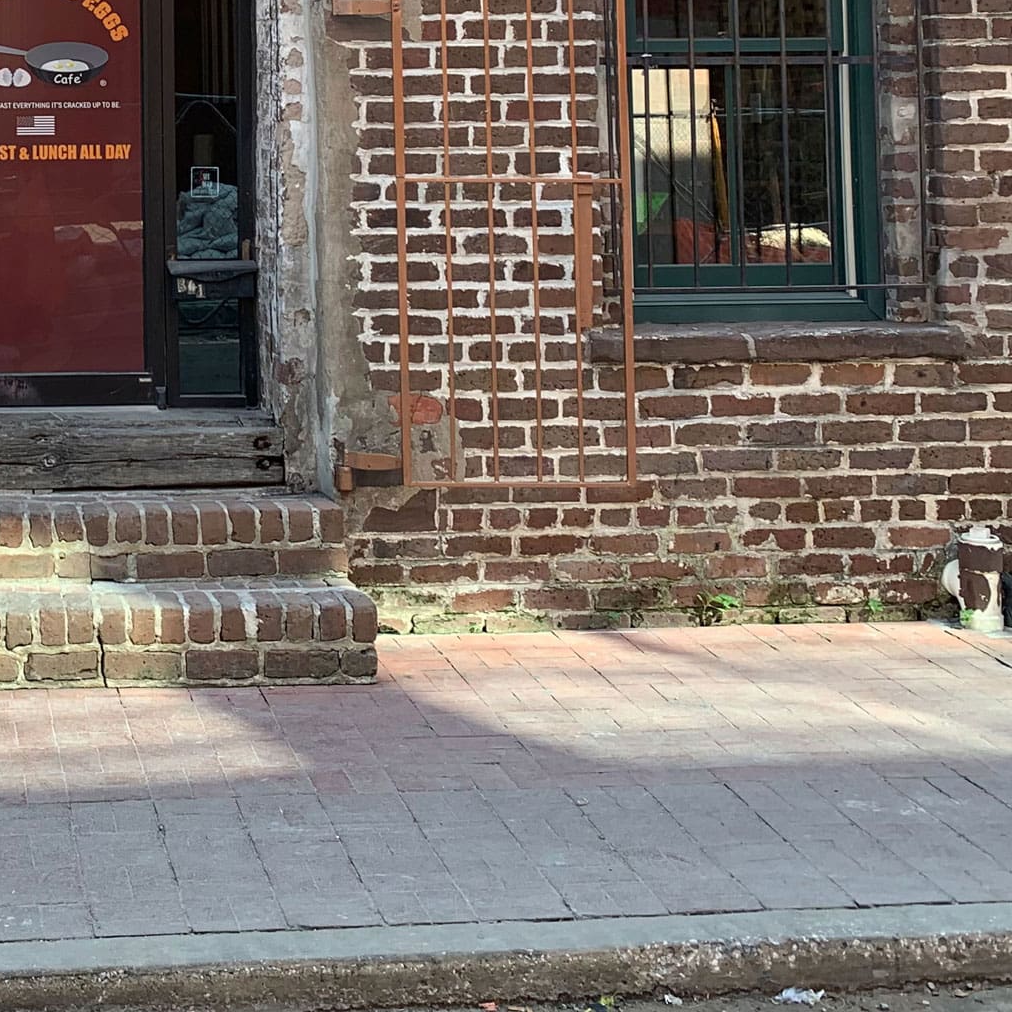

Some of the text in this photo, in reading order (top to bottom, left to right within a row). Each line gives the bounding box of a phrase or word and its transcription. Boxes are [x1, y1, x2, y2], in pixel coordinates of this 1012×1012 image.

[12, 101, 50, 109] EVERYTHING
[51, 101, 63, 109] IT'S
[63, 101, 91, 109] CRACKED
[92, 101, 101, 109] UP
[102, 101, 111, 109] TO
[19, 145, 30, 161] &
[32, 145, 77, 160] LUNCH
[80, 145, 102, 160] ALL
[105, 144, 131, 160] DAY
